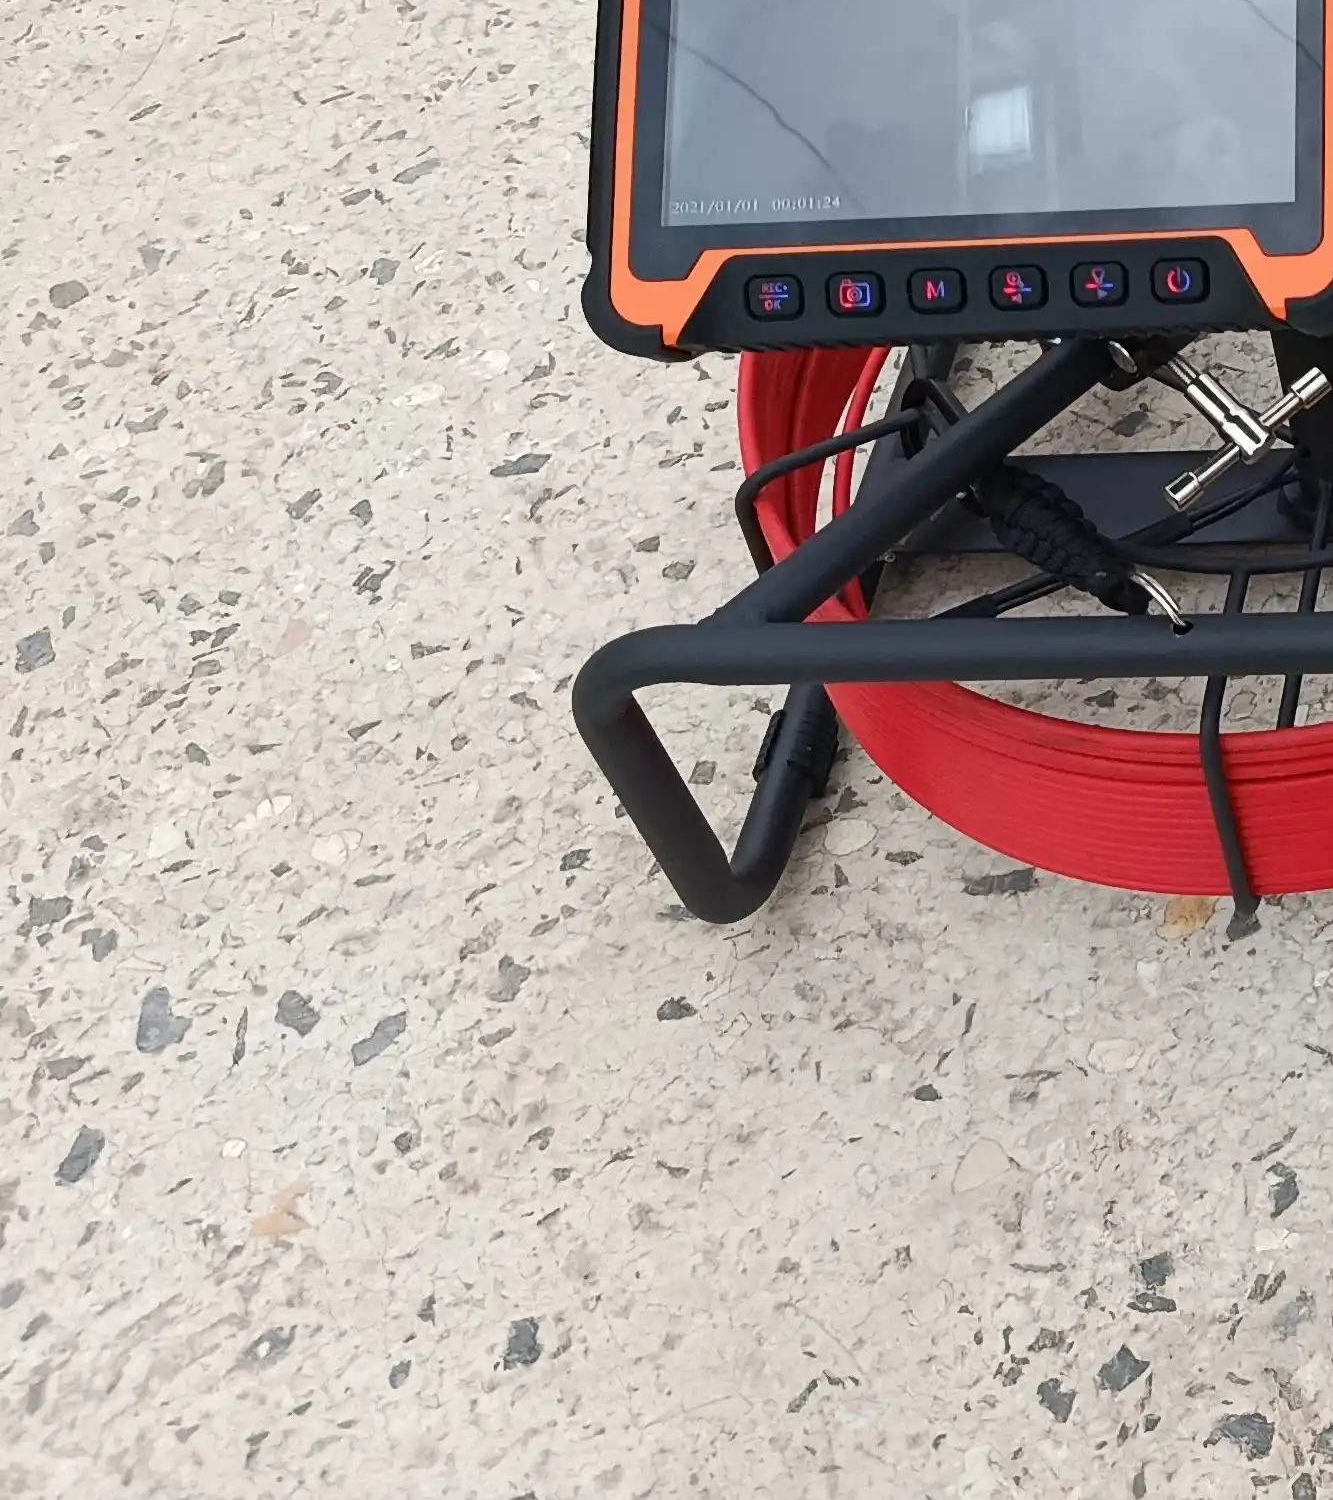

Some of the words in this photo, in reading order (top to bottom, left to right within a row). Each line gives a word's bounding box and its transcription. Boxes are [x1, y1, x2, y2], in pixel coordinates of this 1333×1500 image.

[671, 198, 758, 216] 2021/01/01
[772, 195, 841, 212] 00:01:24
[926, 280, 945, 300] M
[764, 299, 782, 311] OK
